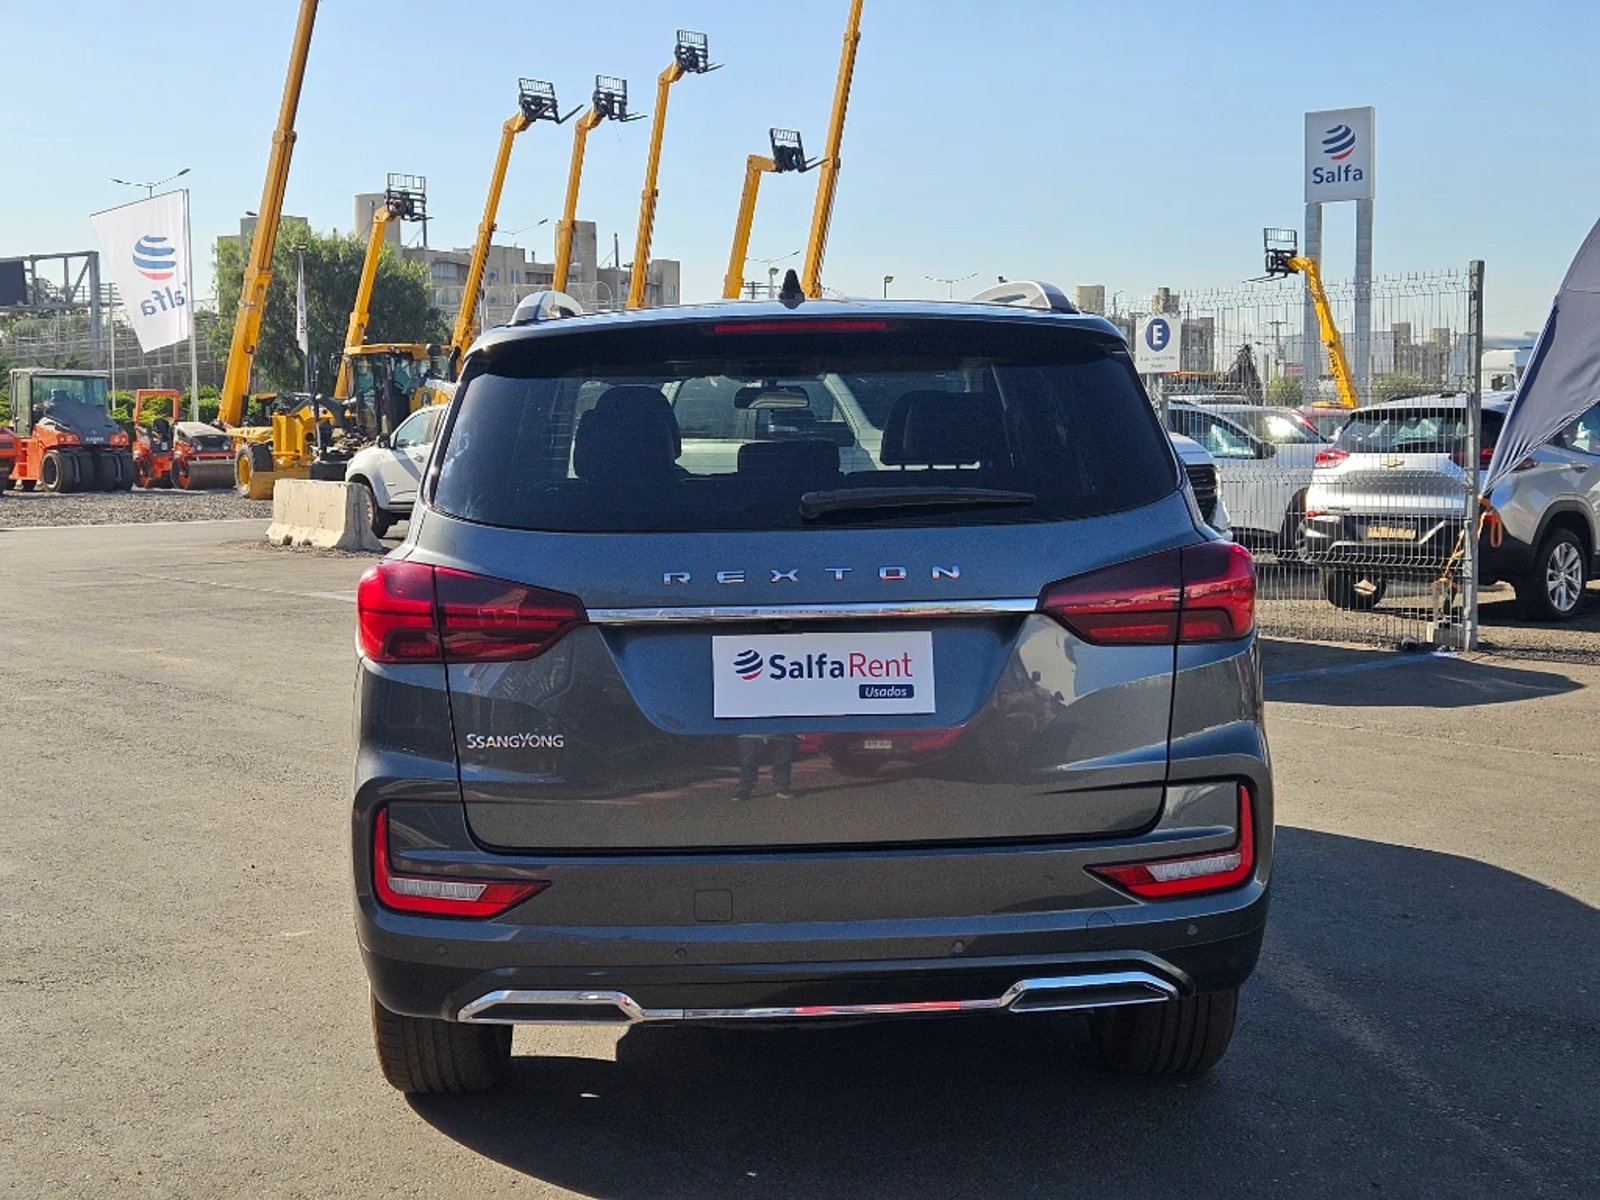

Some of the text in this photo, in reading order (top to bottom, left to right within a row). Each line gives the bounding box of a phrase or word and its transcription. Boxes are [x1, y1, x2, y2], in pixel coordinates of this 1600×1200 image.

[1312, 164, 1363, 184] Salfa
[1152, 324, 1163, 345] E
[663, 565, 960, 585] REXTON
[865, 685, 907, 697] Usados
